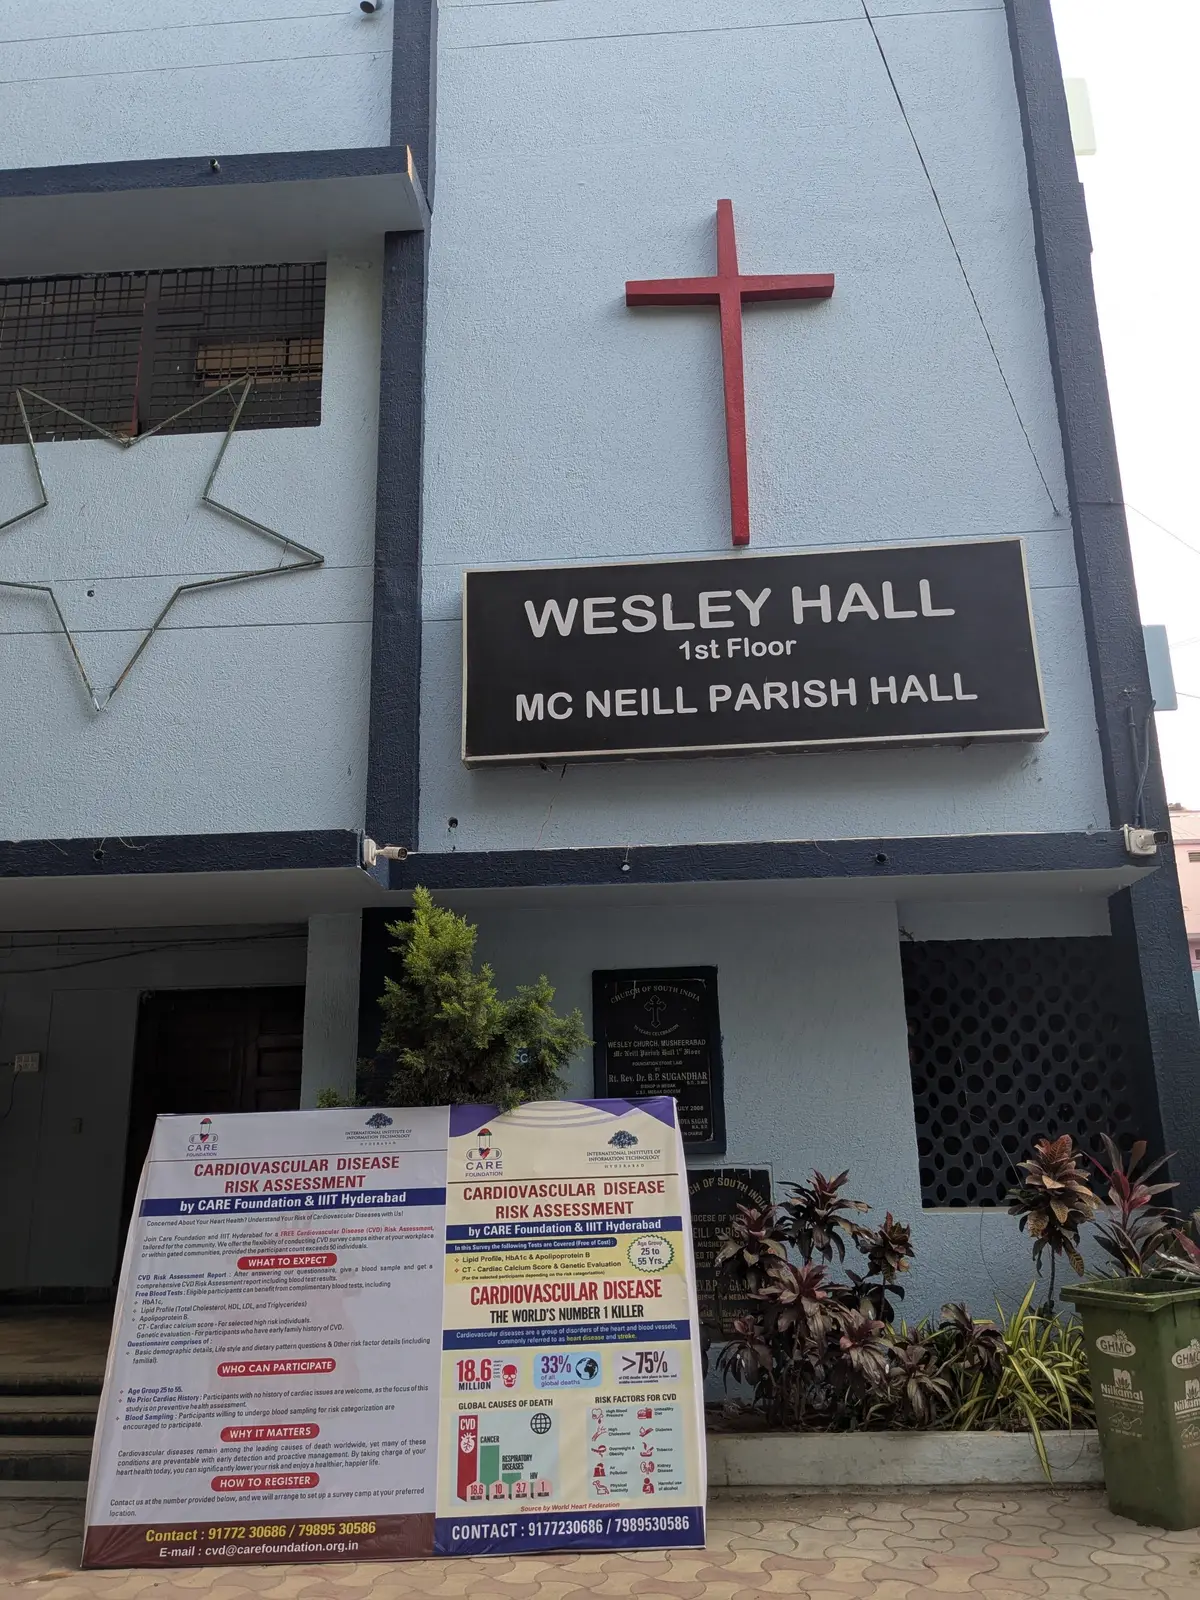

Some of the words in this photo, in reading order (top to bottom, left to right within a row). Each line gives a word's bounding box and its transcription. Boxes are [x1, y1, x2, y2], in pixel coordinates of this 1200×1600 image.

[523, 587, 774, 639] WESLEY
[792, 578, 956, 625] HALL
[678, 639, 721, 661] 1st
[727, 635, 797, 659] Floor
[514, 690, 574, 723] MC
[585, 686, 698, 720] NEILL
[708, 677, 858, 714] PARISH
[869, 672, 979, 705] HALL
[610, 987, 640, 1004] CHURCH
[641, 985, 651, 993] OF
[653, 985, 678, 994] SOUTH
[679, 988, 701, 1002] INDIA
[607, 1040, 632, 1049] WESLEY
[660, 1039, 707, 1047] MUSHEERABAD
[608, 1074, 619, 1083] Rt.
[620, 1074, 635, 1082] Rev.
[636, 1073, 646, 1082] Dr.
[647, 1073, 661, 1081] B.P.
[662, 1072, 708, 1081] SUGANDHAR
[187, 1143, 219, 1152] CARE
[194, 1158, 329, 1177] CARDIOVASCULAR
[336, 1156, 400, 1171] DISEASE
[465, 1160, 503, 1170] CARE
[224, 1179, 260, 1194] RISK
[263, 1175, 366, 1192] ASSESSMENT
[463, 1183, 596, 1201] CARDIOVASCULAR
[603, 1180, 665, 1196] DISEASE
[703, 1178, 715, 1188] OF
[717, 1177, 749, 1192] SOUTH
[748, 1189, 761, 1206] INDIA
[179, 1201, 194, 1214] by
[198, 1199, 231, 1211] CARE
[234, 1198, 301, 1210] Foundation
[304, 1196, 314, 1207] &
[318, 1194, 338, 1206] IIIT
[341, 1191, 407, 1206] Hyderabad
[495, 1205, 529, 1219] RISK
[533, 1201, 634, 1218] ASSESSMENT
[225, 1216, 247, 1224] Health?
[248, 1215, 281, 1223] Understand
[468, 1227, 481, 1238] by
[483, 1224, 511, 1236] CARE
[514, 1223, 573, 1235] Foundation
[574, 1222, 584, 1232] &
[586, 1221, 602, 1232] IIIT
[605, 1219, 662, 1232] Hyderabad
[480, 1254, 504, 1262] Profile,
[535, 1252, 584, 1261] Apolipoprotein
[640, 1248, 650, 1256] 25
[248, 1258, 275, 1267] WHAT
[278, 1258, 291, 1266] TO
[293, 1255, 327, 1265] EXPECT
[637, 1257, 647, 1266] 55
[648, 1257, 664, 1265] Yrs.
[470, 1281, 598, 1306] CARDIOVASCULAR
[603, 1279, 662, 1300] DISEASE
[490, 1309, 508, 1324] THE
[511, 1307, 556, 1323] WORLD'S
[559, 1306, 600, 1321] NUMBER
[603, 1306, 609, 1320] 1
[611, 1304, 644, 1319] KILLER
[1099, 1339, 1132, 1354] GHMC
[222, 1365, 246, 1374] WHO
[248, 1363, 271, 1373] CAN
[273, 1361, 333, 1372] PARTICIPATE
[540, 1355, 572, 1373] 33%
[621, 1350, 668, 1374] >75%
[456, 1358, 492, 1382] 18.6
[458, 1381, 491, 1391] MILLION
[540, 1380, 560, 1388] global
[560, 1378, 581, 1387] deaths
[1100, 1383, 1144, 1401] Nilkamal
[458, 1401, 487, 1410] GLOBAL
[488, 1400, 517, 1409] CAUSES
[518, 1399, 528, 1408] OF
[529, 1398, 554, 1408] DEATH
[594, 1396, 612, 1405] RISK
[613, 1394, 645, 1404] FACTORS
[646, 1394, 661, 1402] FOR
[662, 1393, 677, 1402] CVD
[460, 1418, 476, 1431] CVD
[229, 1429, 253, 1439] WHY
[255, 1428, 264, 1438] IT
[266, 1427, 311, 1437] MATTERS
[480, 1435, 500, 1444] CANCER
[502, 1454, 533, 1463] RESPIRATORY
[502, 1462, 525, 1471] DISEASES
[219, 1479, 246, 1488] HOW
[248, 1478, 262, 1487] TO
[264, 1475, 311, 1486] REGISTER
[529, 1472, 538, 1480] HIV
[469, 1484, 484, 1495] 18.6
[494, 1483, 503, 1494] 10
[516, 1482, 526, 1493] 3.7
[540, 1481, 545, 1492] 1
[542, 1505, 551, 1513] by
[551, 1503, 569, 1511] World
[570, 1502, 588, 1510] Heart
[588, 1501, 620, 1509] Federation
[145, 1529, 198, 1542] Contact
[201, 1530, 204, 1540] :
[208, 1526, 246, 1540] 91772
[248, 1525, 287, 1538] 30686
[288, 1524, 296, 1538] /
[298, 1523, 336, 1537] 79895
[338, 1521, 377, 1535] 30586
[451, 1522, 518, 1540] CONTACT
[521, 1527, 525, 1537] :
[528, 1518, 603, 1537] 9177230686
[606, 1518, 612, 1535] /
[614, 1515, 690, 1533] 7989530586
[159, 1546, 195, 1558] E-mail
[198, 1547, 202, 1556] :
[204, 1540, 359, 1557] cvd@carefoundation.org.in
